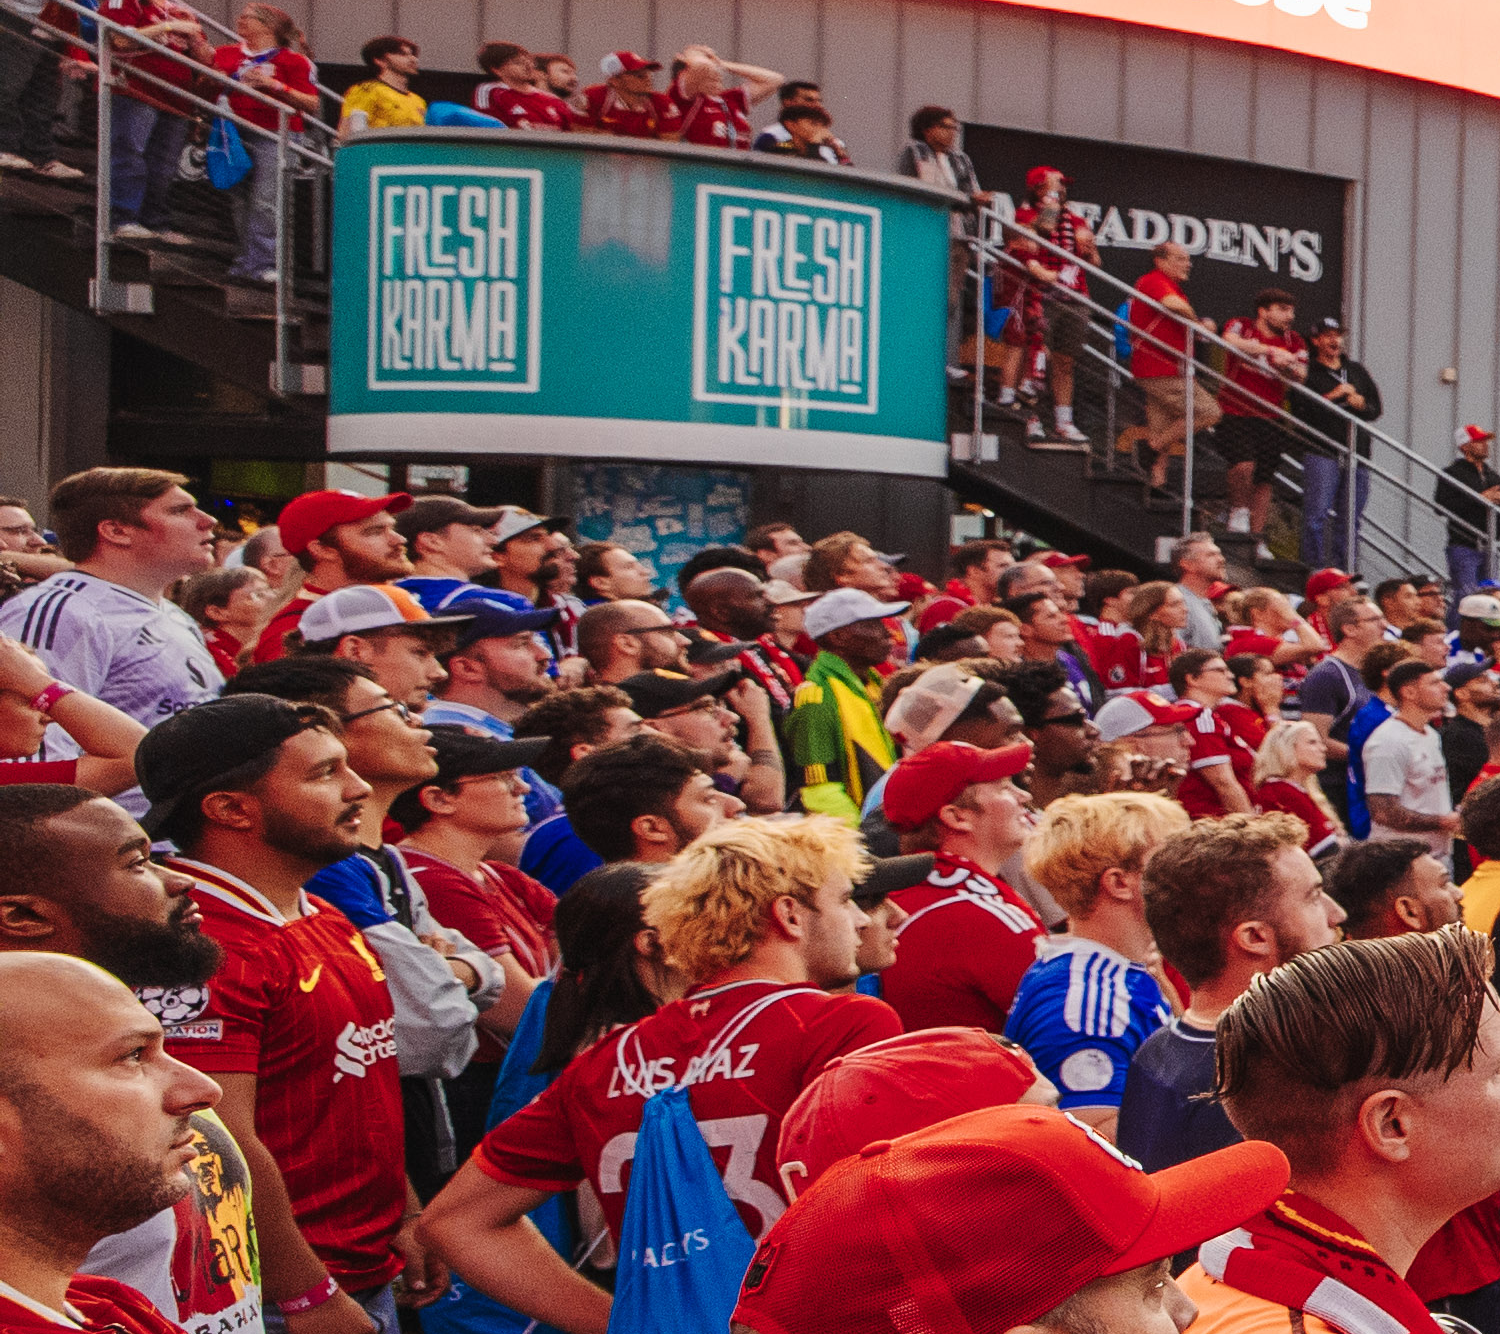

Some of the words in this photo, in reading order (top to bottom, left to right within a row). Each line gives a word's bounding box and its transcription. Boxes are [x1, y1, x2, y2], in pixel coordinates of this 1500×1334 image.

[382, 185, 519, 279] FRESH
[719, 206, 865, 307] FRESH
[982, 191, 1324, 283] MFADDEN'S
[381, 280, 517, 373] KARMA
[717, 297, 864, 395] KARMA
